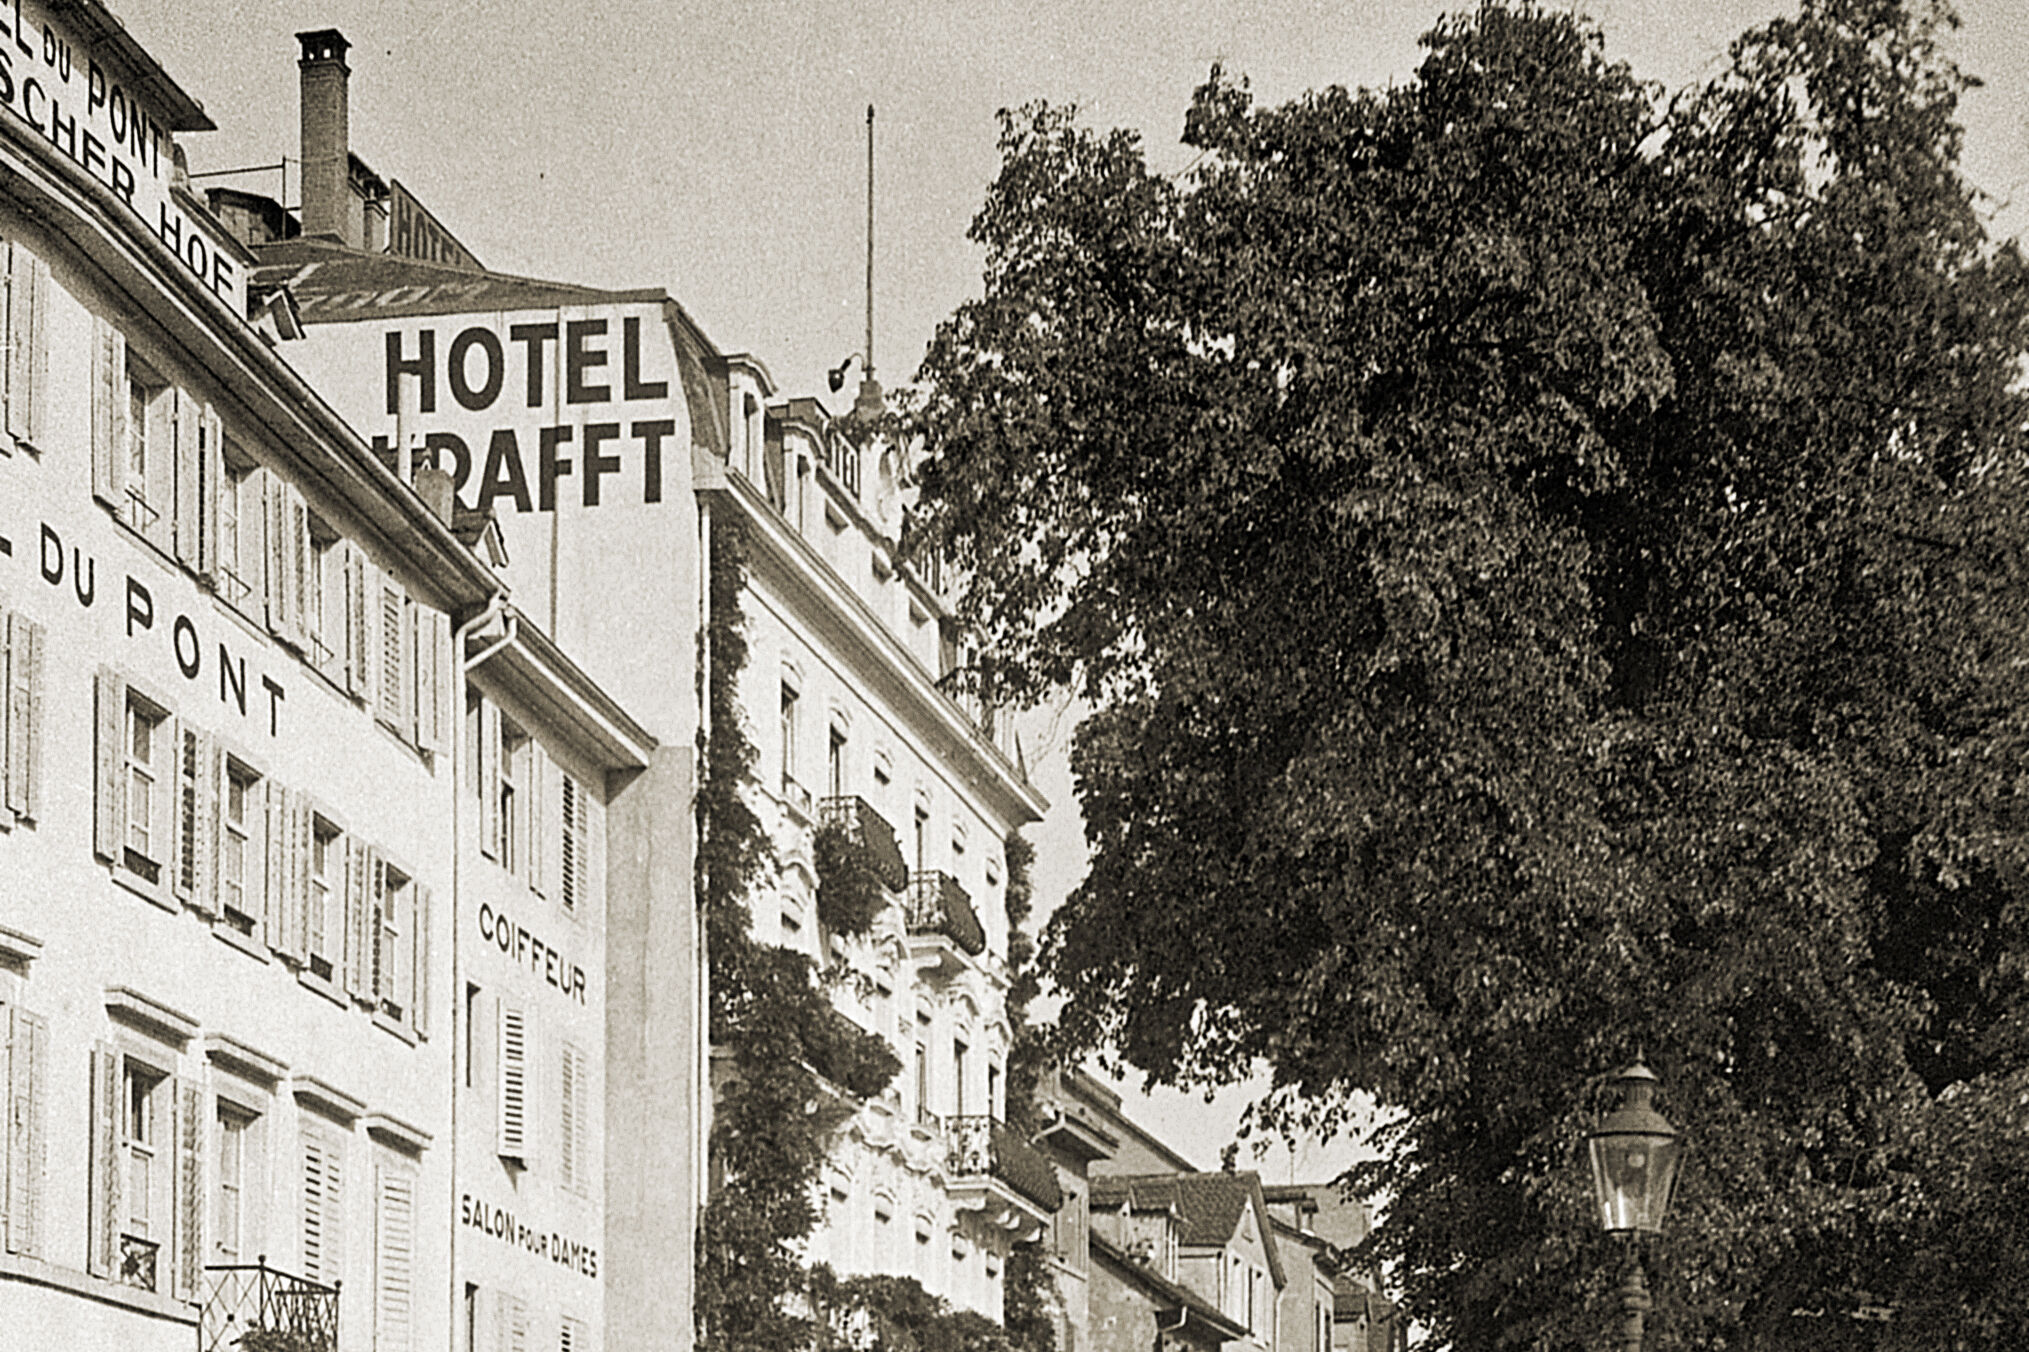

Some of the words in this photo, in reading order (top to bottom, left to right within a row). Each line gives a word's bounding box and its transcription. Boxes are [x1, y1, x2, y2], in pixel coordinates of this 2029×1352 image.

[43, 23, 70, 84] DU
[88, 57, 163, 179] PONT
[160, 201, 233, 294] HOF
[386, 316, 668, 415] HOTEL
[41, 521, 94, 608] DU
[127, 574, 285, 737] PONT
[479, 902, 586, 1006] COIFFEUR
[462, 1194, 515, 1245] SALON
[518, 1224, 548, 1259] POUR
[552, 1232, 597, 1279] DAMES
